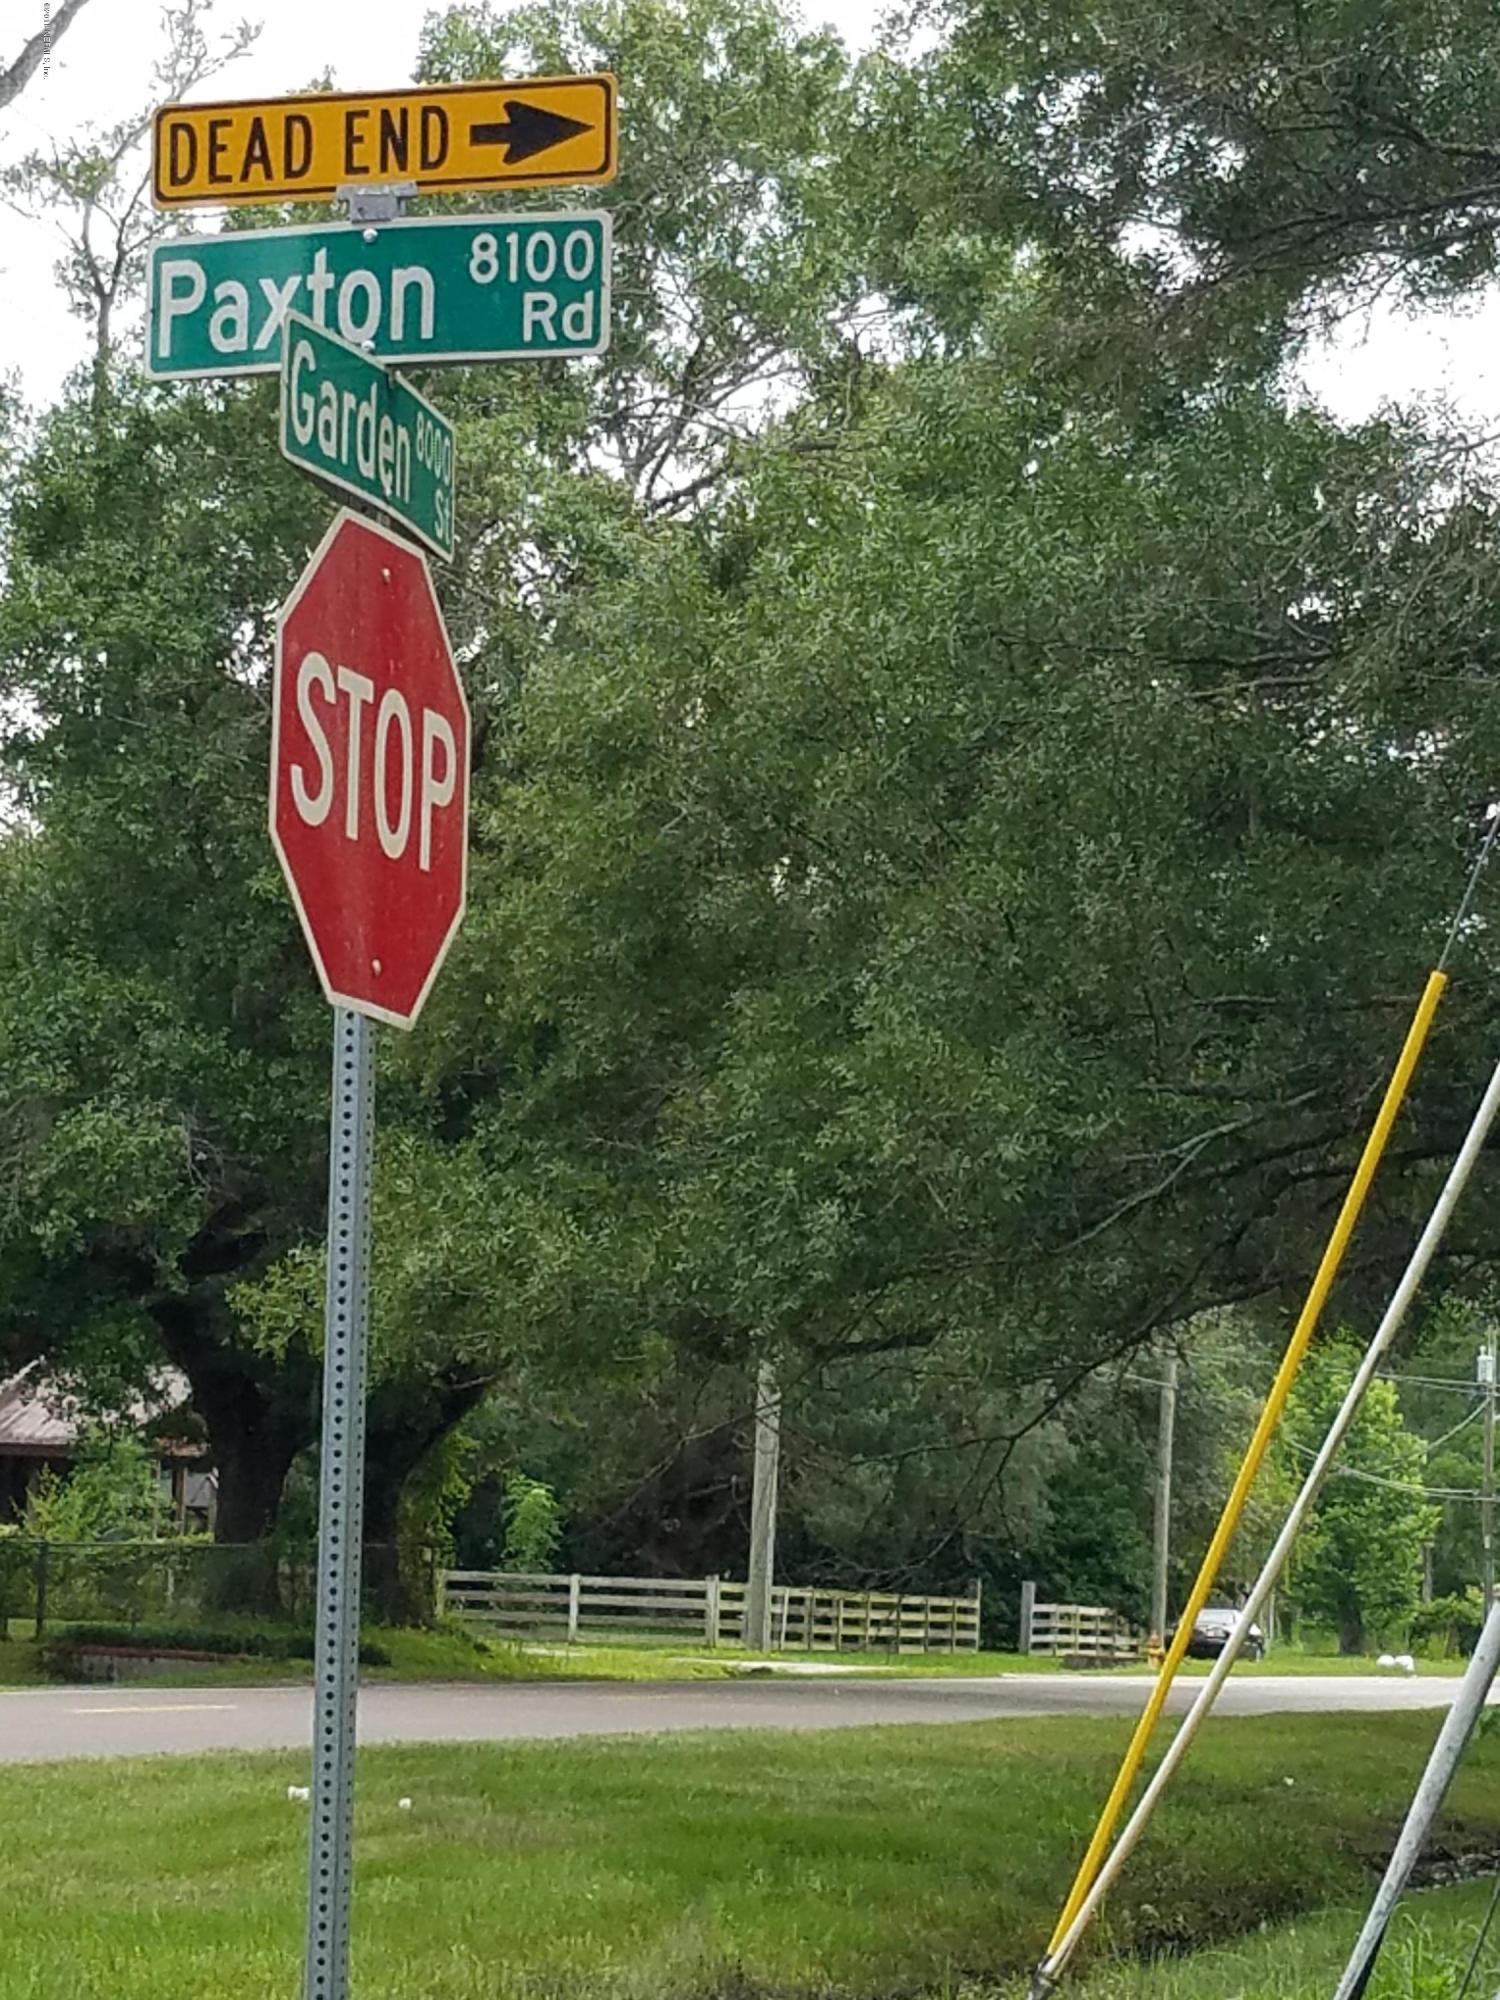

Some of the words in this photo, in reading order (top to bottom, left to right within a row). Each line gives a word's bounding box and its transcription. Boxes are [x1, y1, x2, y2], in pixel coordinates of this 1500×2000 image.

[168, 114, 312, 187] DEAD
[344, 105, 450, 175] END
[469, 229, 595, 284] 8100
[157, 247, 436, 358] Paxton
[522, 289, 595, 343] Rd
[291, 339, 411, 504] Garden
[416, 411, 452, 486] 8000
[434, 488, 452, 545] St
[290, 651, 457, 873] STOP
